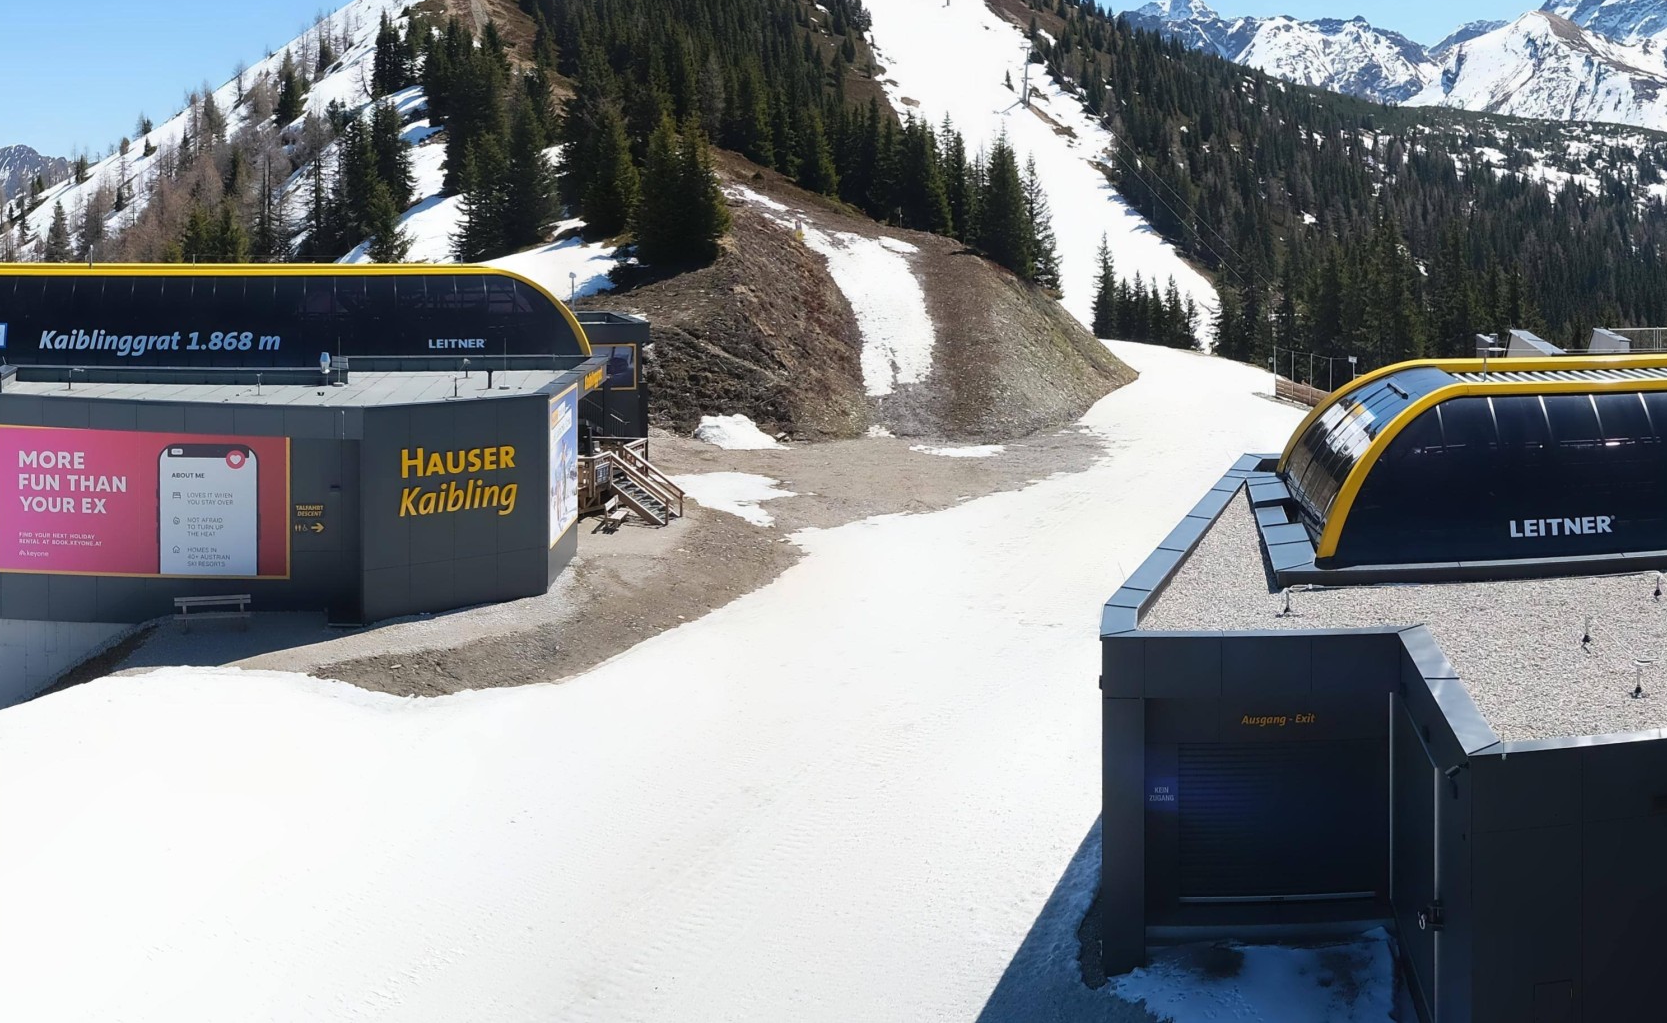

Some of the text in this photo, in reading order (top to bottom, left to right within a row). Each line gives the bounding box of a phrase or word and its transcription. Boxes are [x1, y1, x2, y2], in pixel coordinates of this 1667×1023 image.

[38, 330, 281, 356] Kaiblinggrat 1.868 m
[428, 338, 485, 349] LEITNER
[18, 450, 85, 469] MORE
[401, 445, 516, 479] HAUSER
[18, 473, 127, 493] FUN THAN
[19, 496, 107, 514] YOUR EX
[399, 479, 518, 517] Kaibling
[1509, 516, 1615, 538] LEITNER
[26, 550, 49, 558] keyone
[1241, 715, 1286, 727] Ausgang
[1295, 713, 1316, 723] Exit
